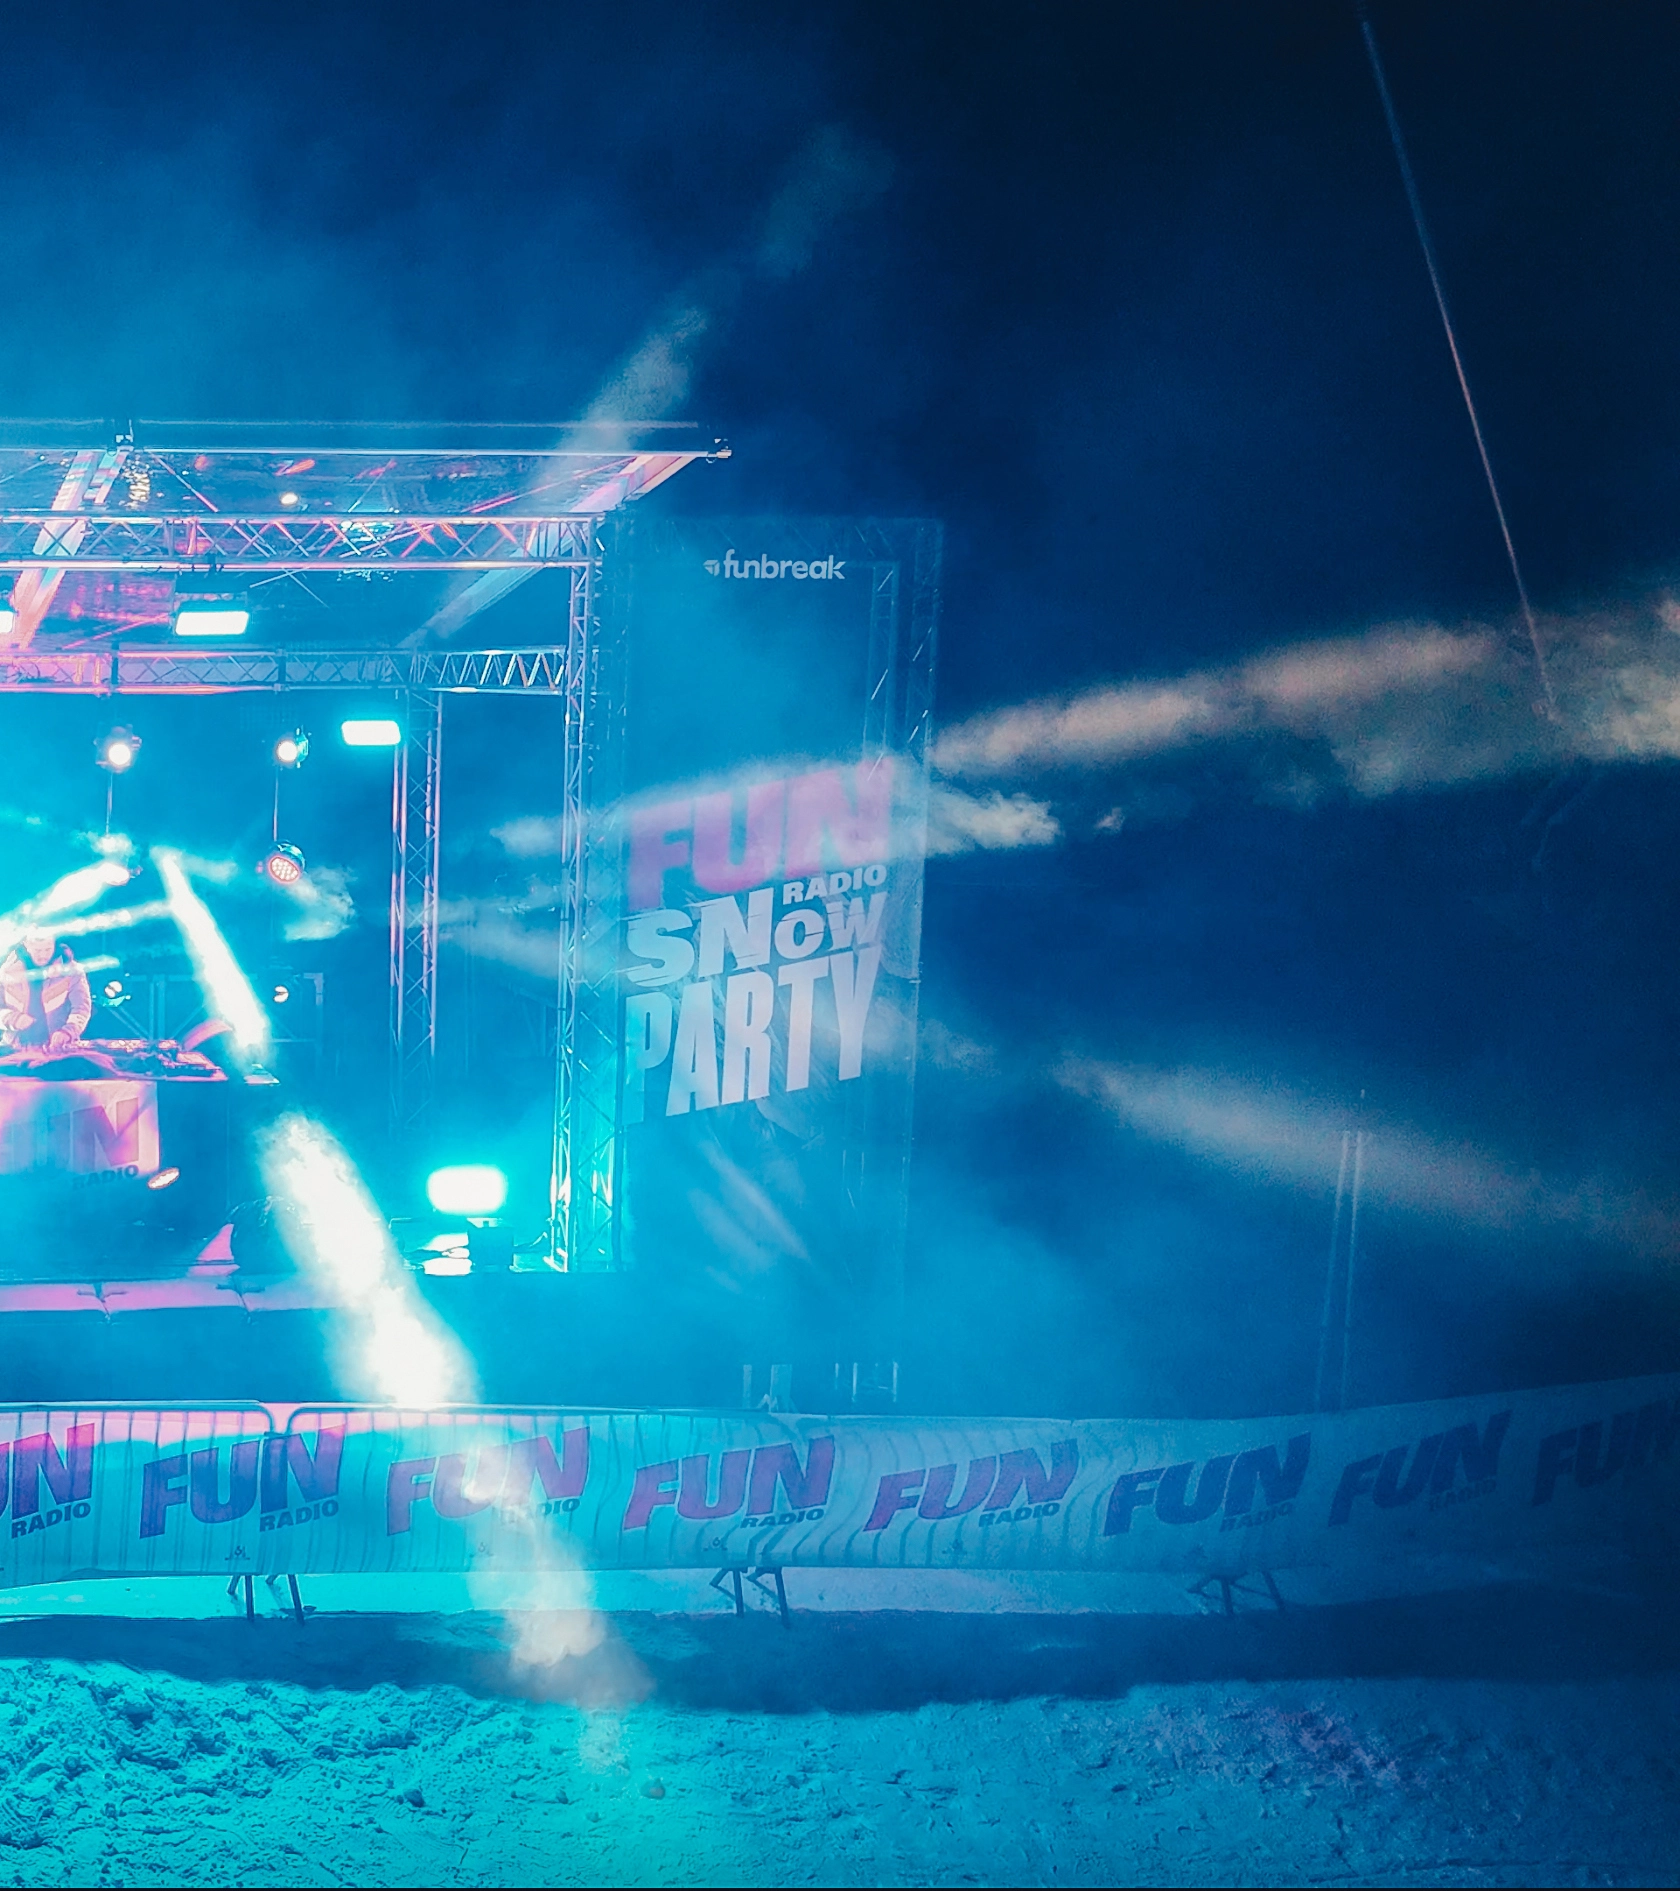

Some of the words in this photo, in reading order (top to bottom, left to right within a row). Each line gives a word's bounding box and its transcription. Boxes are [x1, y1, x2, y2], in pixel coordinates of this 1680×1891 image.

[723, 548, 846, 581] funbreak
[627, 758, 894, 911] FUN
[782, 864, 887, 906] RADIO
[625, 946, 883, 1123] PARTY
[72, 1164, 140, 1191] RADIO
[140, 1423, 346, 1540] FUN
[258, 1498, 340, 1533] RADIO
[387, 1426, 591, 1536] FUN
[623, 1435, 835, 1531] FUN
[863, 1438, 1078, 1532] FUN
[979, 1502, 1061, 1528] RADIO
[1102, 1431, 1312, 1537] FUN
[1327, 1410, 1513, 1528] FUN
[10, 1502, 91, 1538] RADIO
[740, 1507, 825, 1529] RADIO
